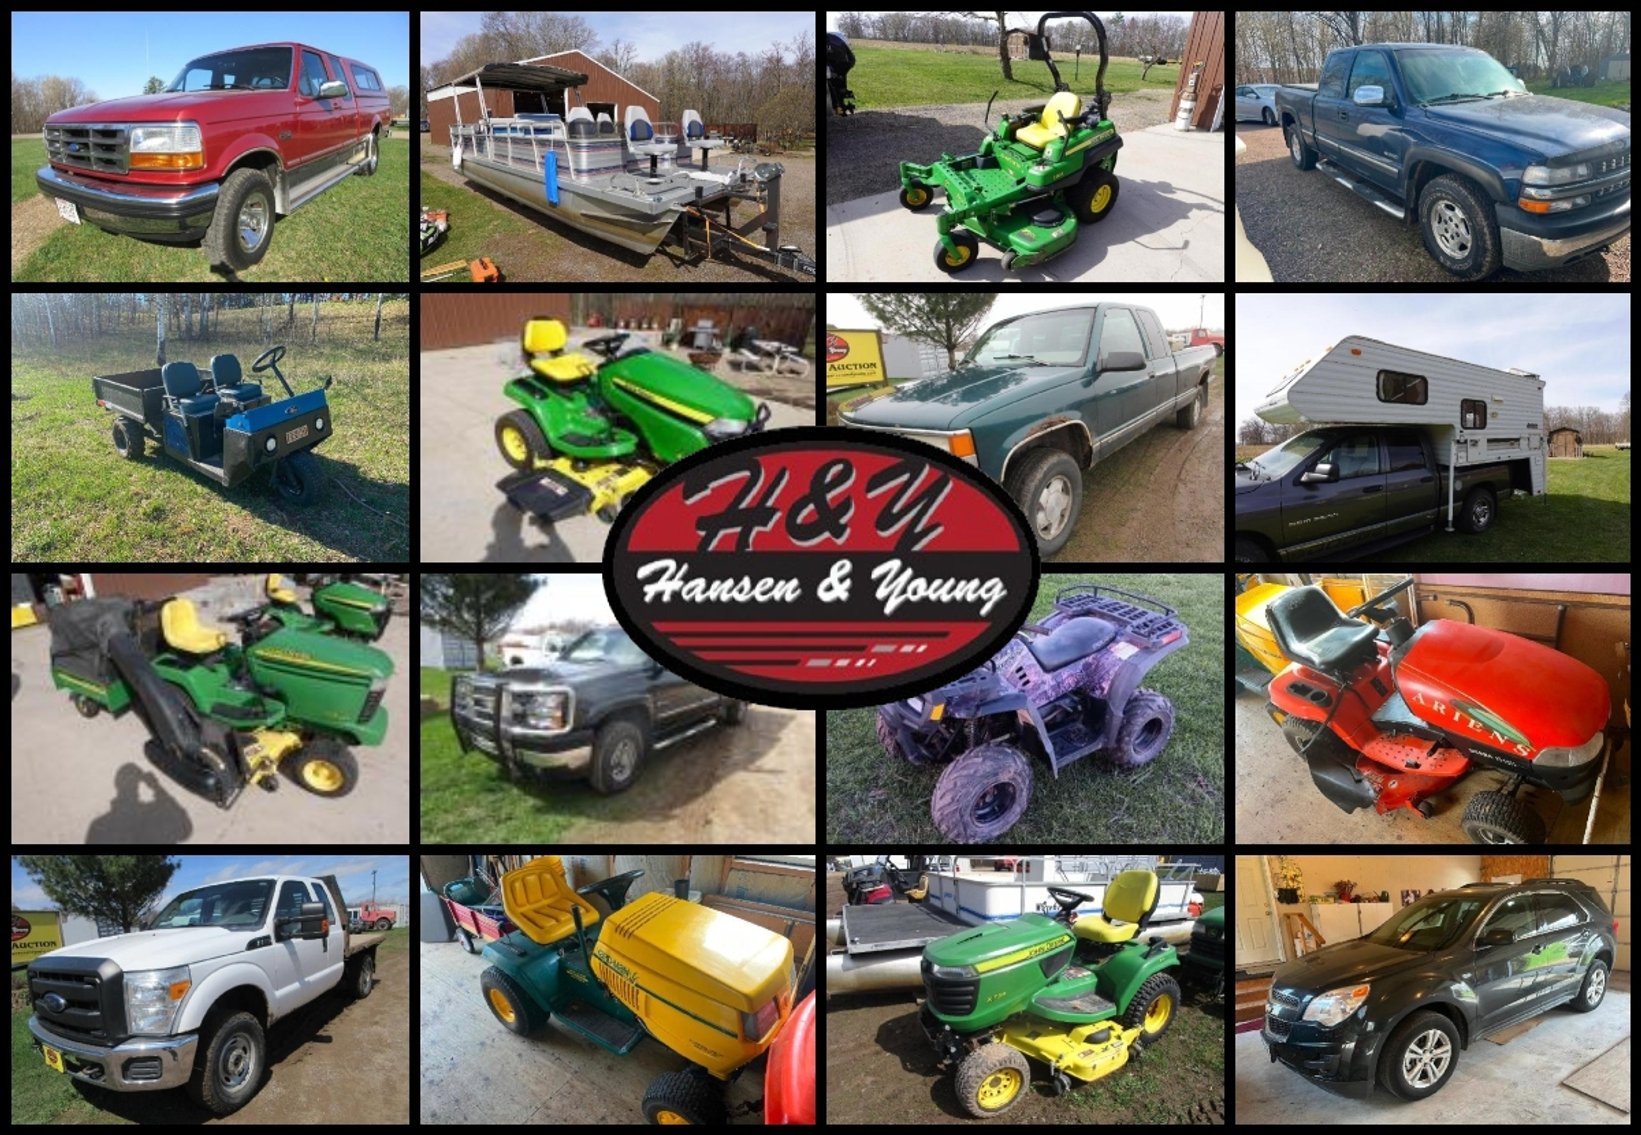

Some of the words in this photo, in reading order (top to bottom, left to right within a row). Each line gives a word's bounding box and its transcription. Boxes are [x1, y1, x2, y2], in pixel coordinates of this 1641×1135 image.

[829, 362, 877, 371] AUCTION
[1412, 692, 1530, 757] ARIENS
[12, 940, 57, 949] AUCTION
